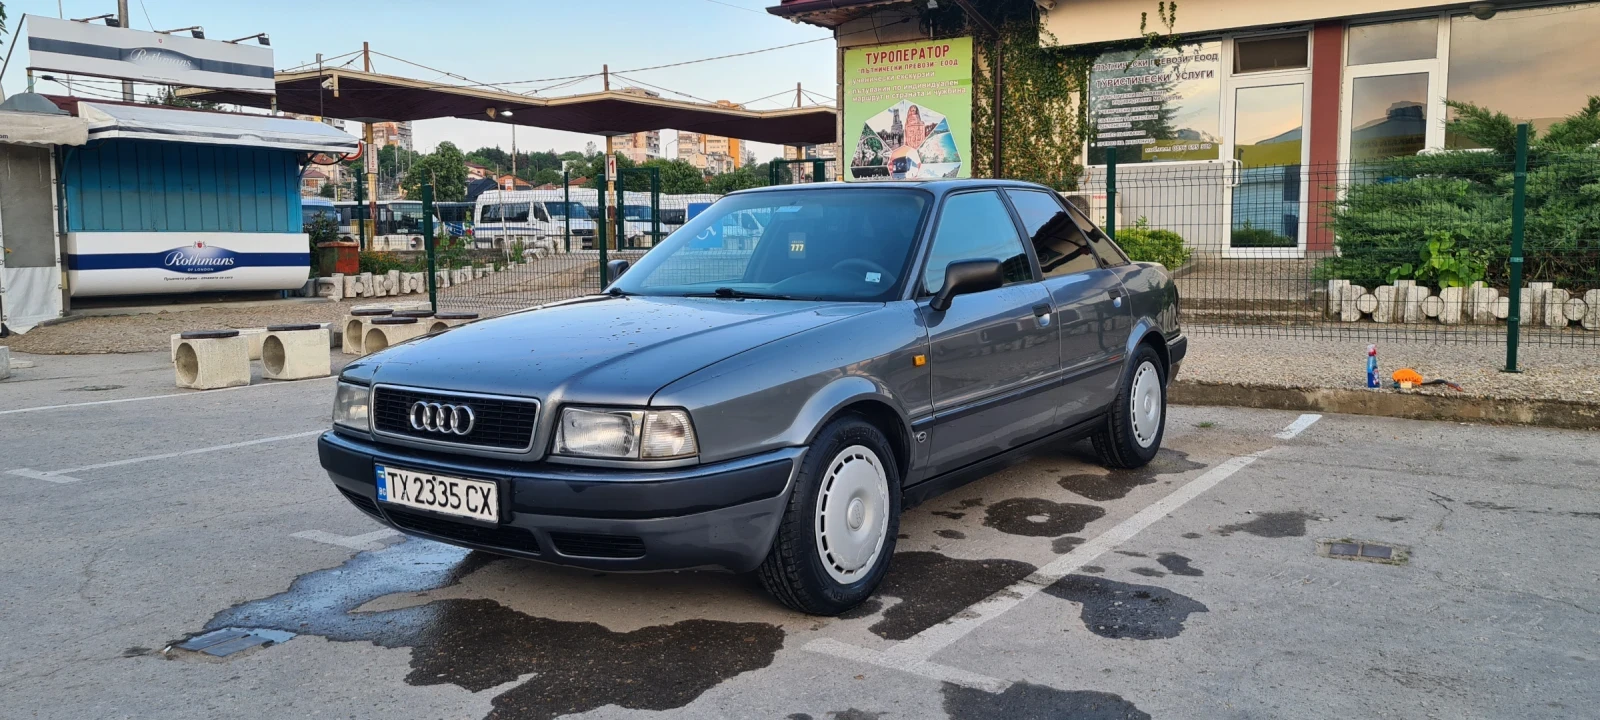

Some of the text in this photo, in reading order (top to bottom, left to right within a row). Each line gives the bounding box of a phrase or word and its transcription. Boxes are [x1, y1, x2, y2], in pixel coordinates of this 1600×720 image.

[131, 48, 191, 66] Rothmans
[865, 44, 950, 65] ТУРОПЕРАТОР
[1194, 53, 1219, 62] ЕООД
[940, 59, 958, 67] ЕООД
[896, 71, 935, 80] екскурзии
[1096, 69, 1214, 88] ТУРИСТИЧЕСКИ УСЛУГИ
[891, 90, 925, 99] страната
[610, 160, 614, 174] 1
[800, 167, 805, 180] 2
[790, 244, 804, 252] 777
[164, 251, 235, 266] Rothmans
[378, 486, 387, 496] BG
[387, 471, 492, 516] TX 2335 CX
